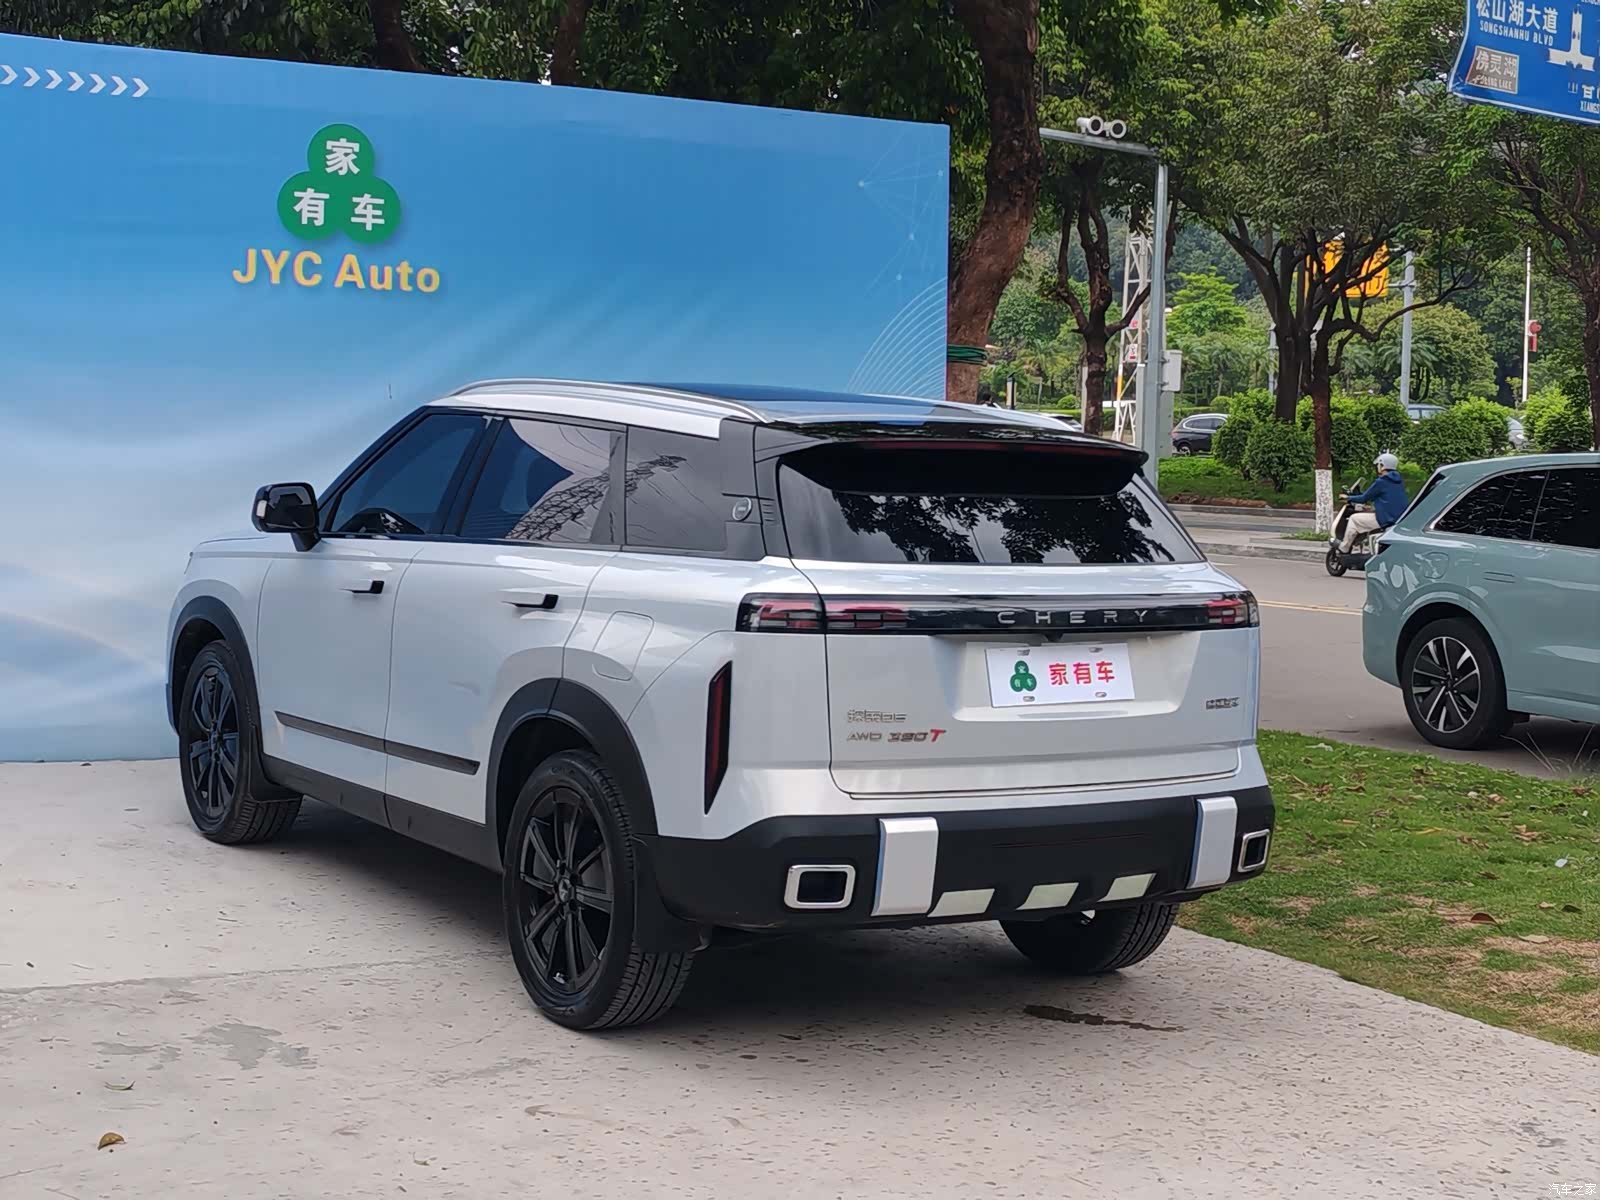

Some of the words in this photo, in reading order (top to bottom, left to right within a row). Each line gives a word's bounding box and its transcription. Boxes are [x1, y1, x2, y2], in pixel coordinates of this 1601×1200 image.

[1475, 0, 1558, 34] 松山湖大道
[1479, 20, 1530, 42] SONGSHANHU
[1532, 31, 1554, 47] BLVD
[231, 247, 323, 287] JYC
[333, 252, 441, 293] Auto
[996, 607, 1150, 626] CHERY
[1048, 660, 1116, 687] 家有车
[846, 731, 882, 742] AWD
